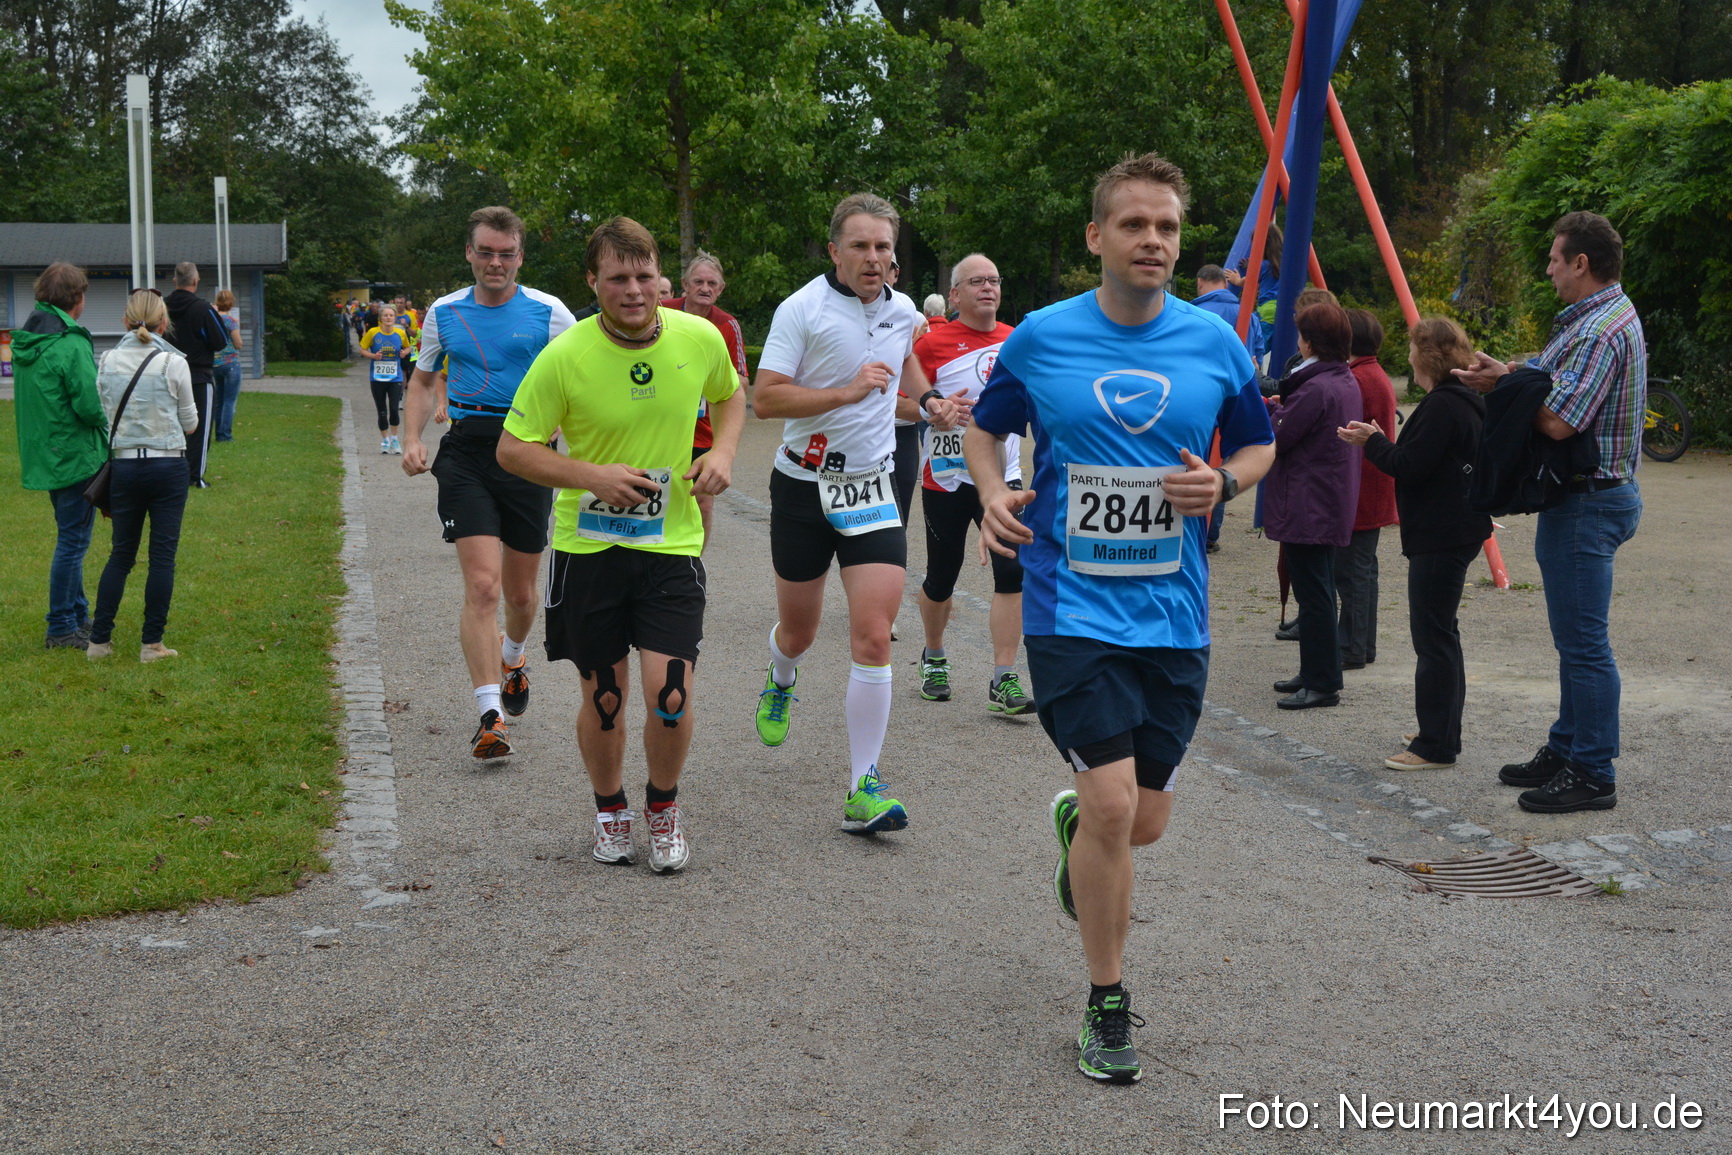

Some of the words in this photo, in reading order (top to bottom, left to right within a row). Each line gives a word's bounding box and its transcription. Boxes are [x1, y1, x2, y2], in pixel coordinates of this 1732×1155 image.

[376, 366, 395, 374] 2705
[631, 385, 657, 397] Partl
[933, 434, 964, 456] 286
[819, 473, 845, 482] PARTL
[846, 468, 880, 482] Neumarkt
[1071, 474, 1108, 487] PARTL
[1112, 477, 1163, 488] Neumark
[827, 476, 885, 510] 2041
[844, 509, 882, 526] Michael
[1079, 492, 1174, 534] 2844
[609, 519, 638, 535] Felix
[1093, 543, 1157, 560] Manfred
